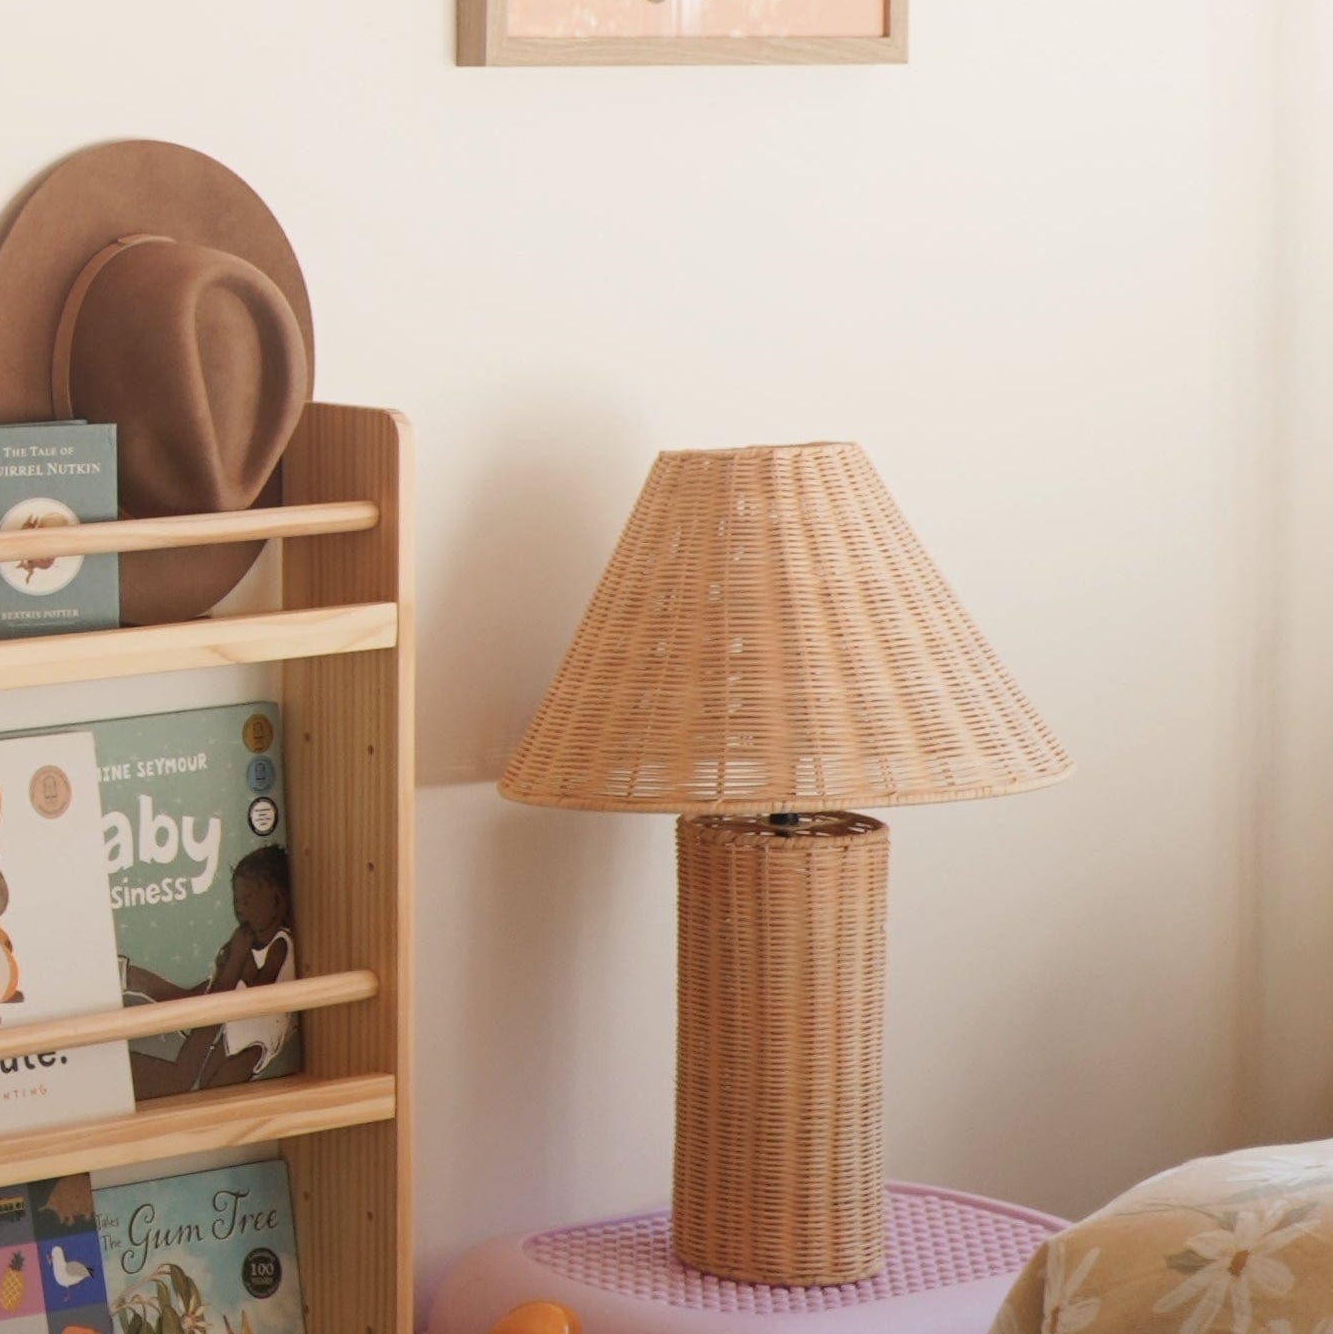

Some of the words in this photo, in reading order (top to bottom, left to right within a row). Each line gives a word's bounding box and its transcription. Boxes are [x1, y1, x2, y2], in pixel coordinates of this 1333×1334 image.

[46, 462, 101, 475] NUTKIN
[136, 753, 208, 778] SEYMOUR
[102, 794, 222, 894] aby
[111, 877, 187, 909] siness
[121, 1203, 203, 1274] Gum
[211, 1188, 278, 1240] Tree
[251, 1262, 274, 1276] 100
